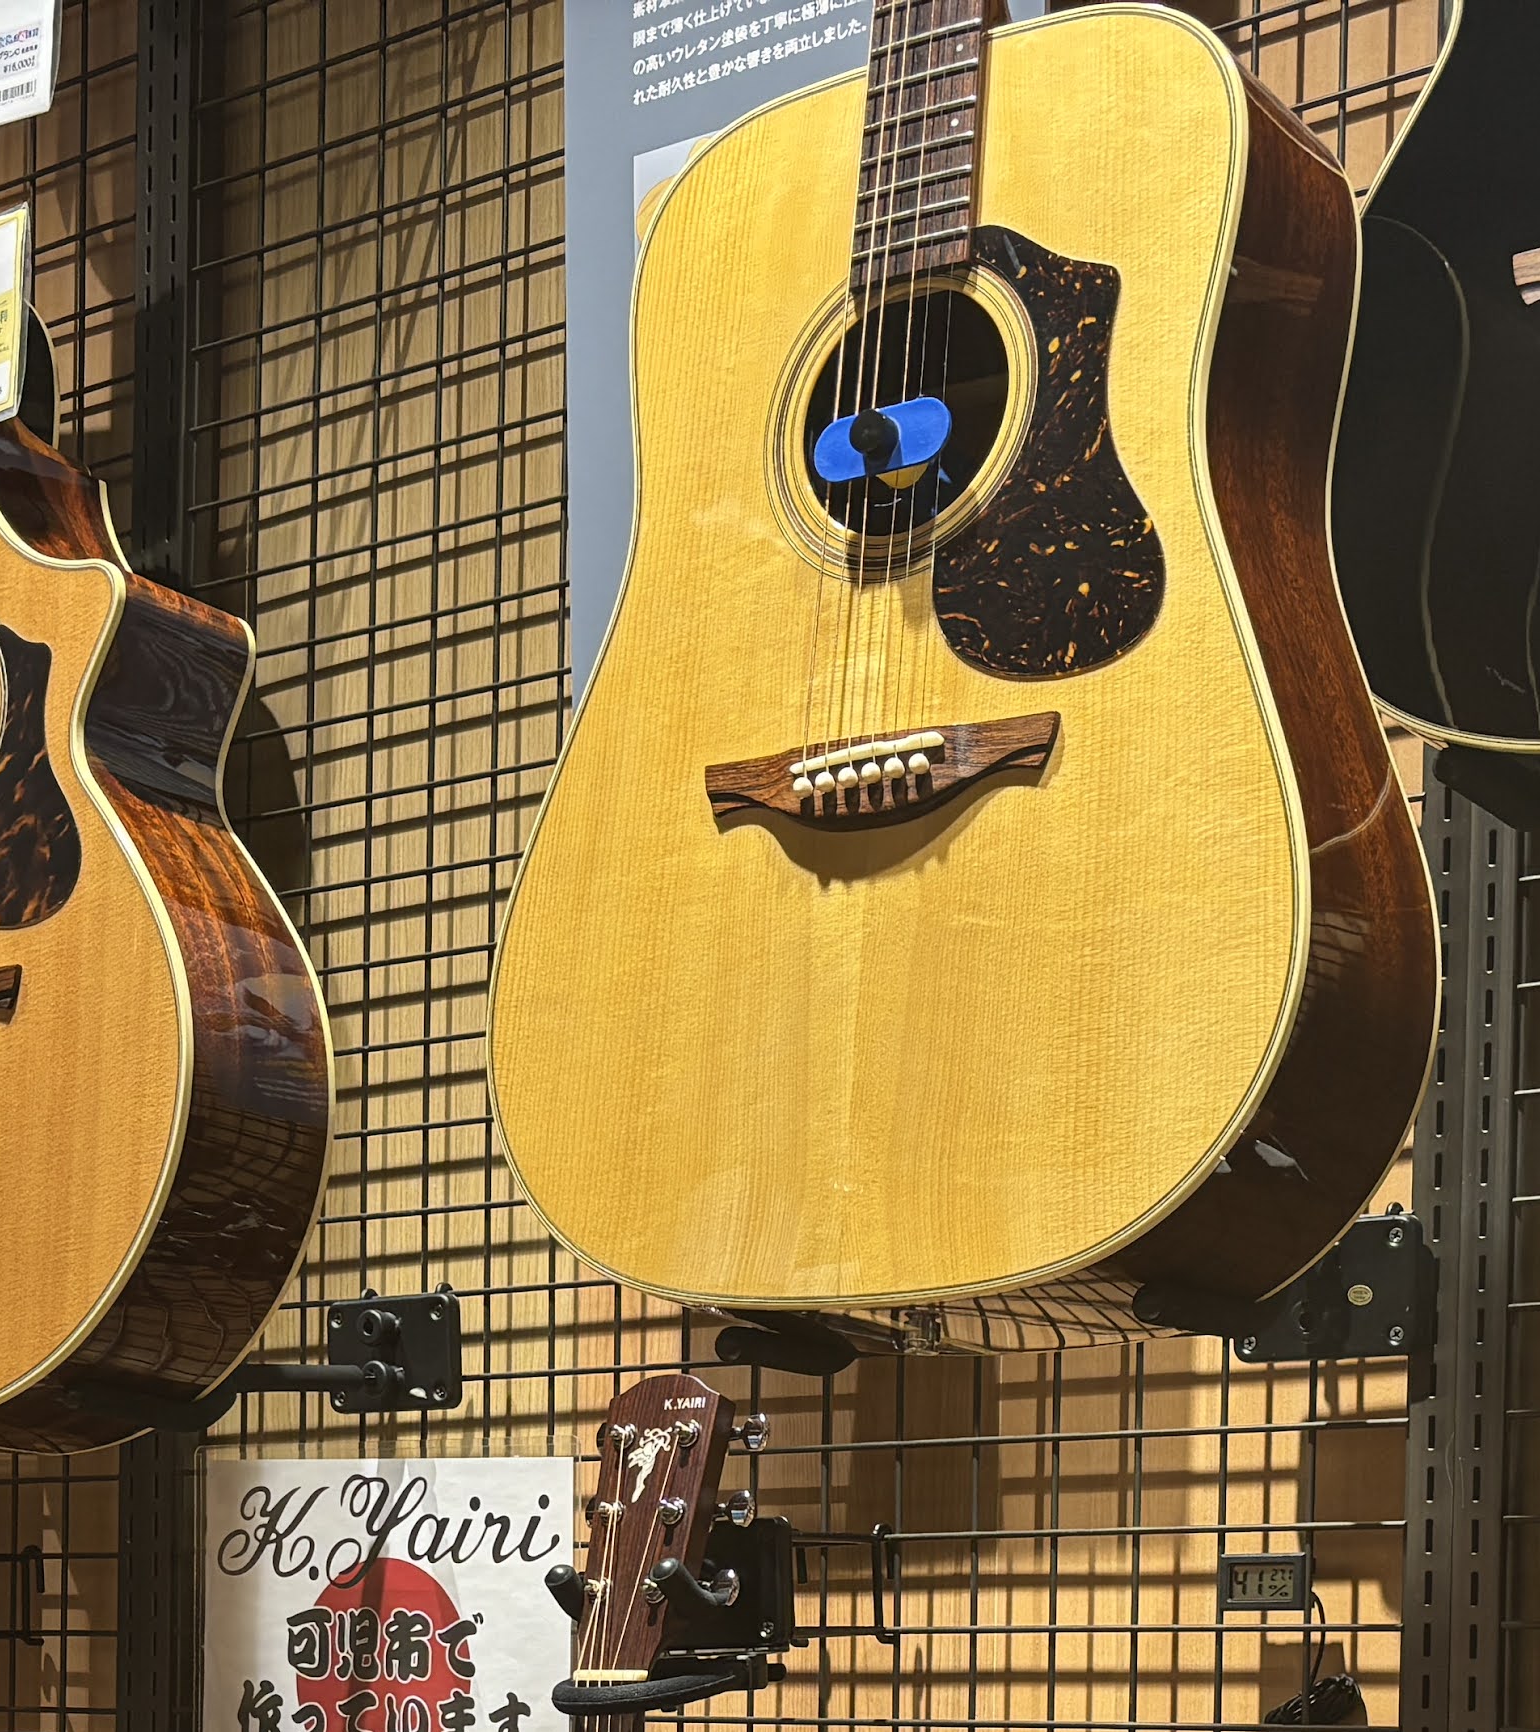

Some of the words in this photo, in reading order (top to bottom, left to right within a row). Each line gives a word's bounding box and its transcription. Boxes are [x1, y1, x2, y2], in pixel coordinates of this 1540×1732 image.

[664, 1397, 706, 1411] K.YAIRI
[286, 1606, 484, 1684] 可児市で
